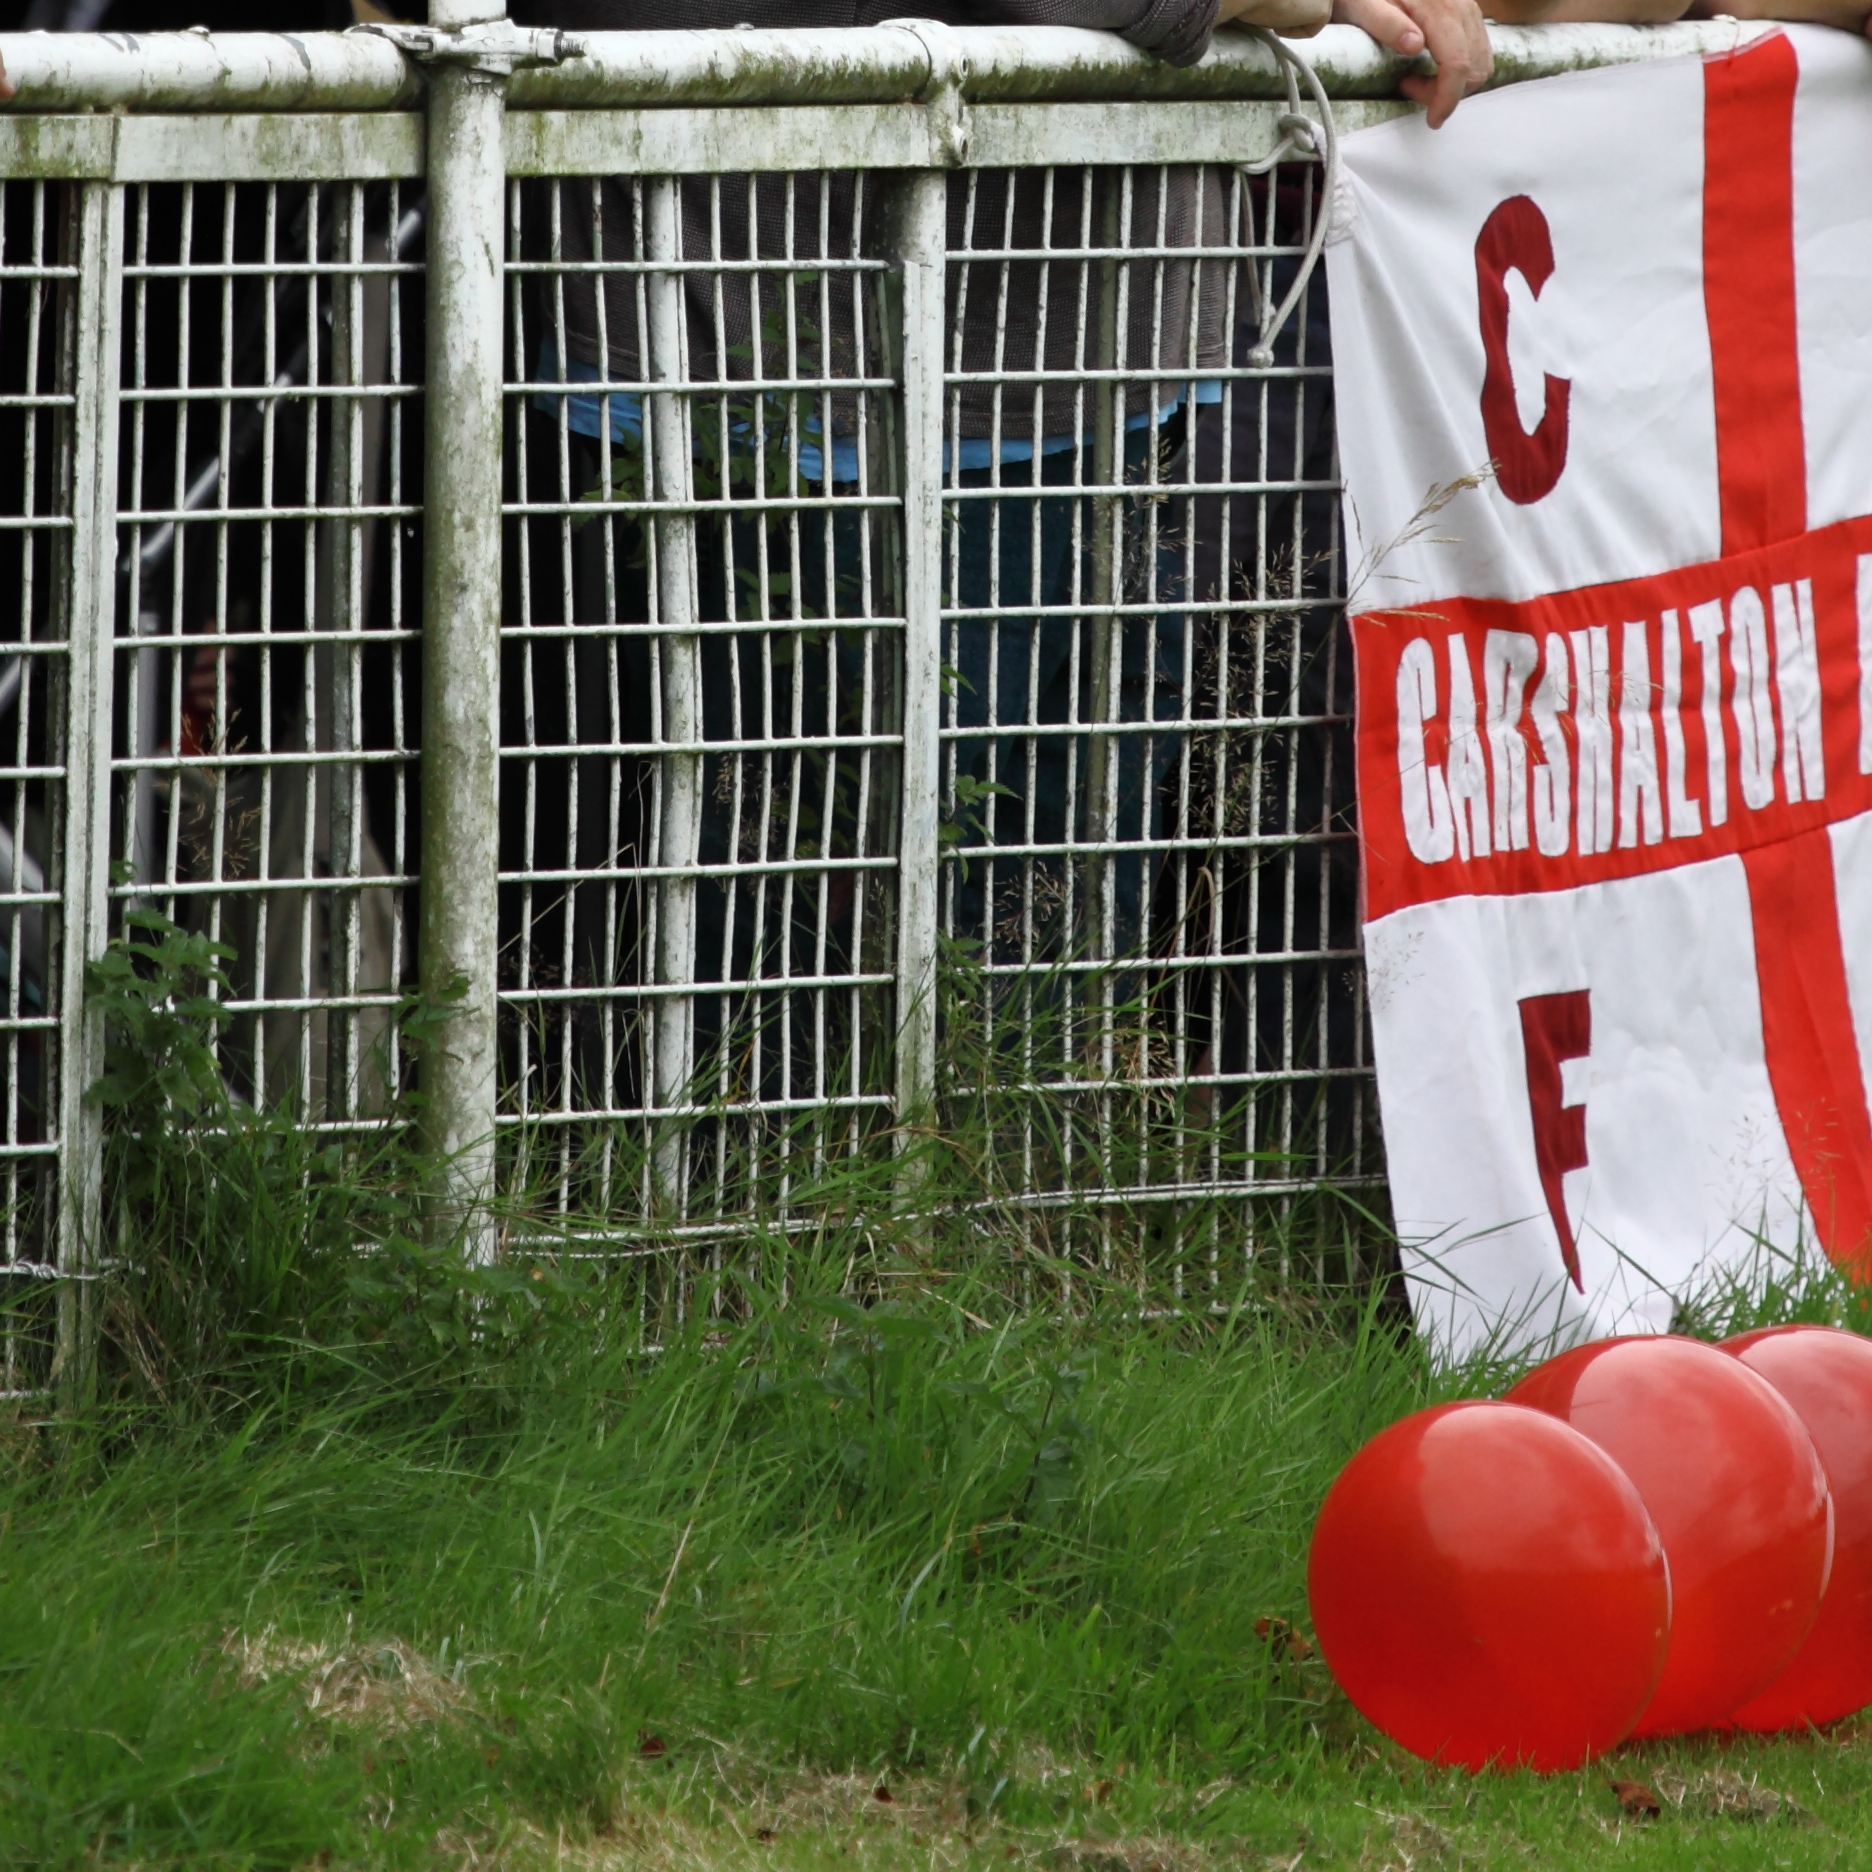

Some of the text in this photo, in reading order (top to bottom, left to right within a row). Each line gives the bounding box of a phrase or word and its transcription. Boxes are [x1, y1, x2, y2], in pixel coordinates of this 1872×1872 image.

[1475, 194, 1571, 506] C
[1396, 577, 1826, 865] CARSHALTON
[1517, 988, 1591, 1295] F
